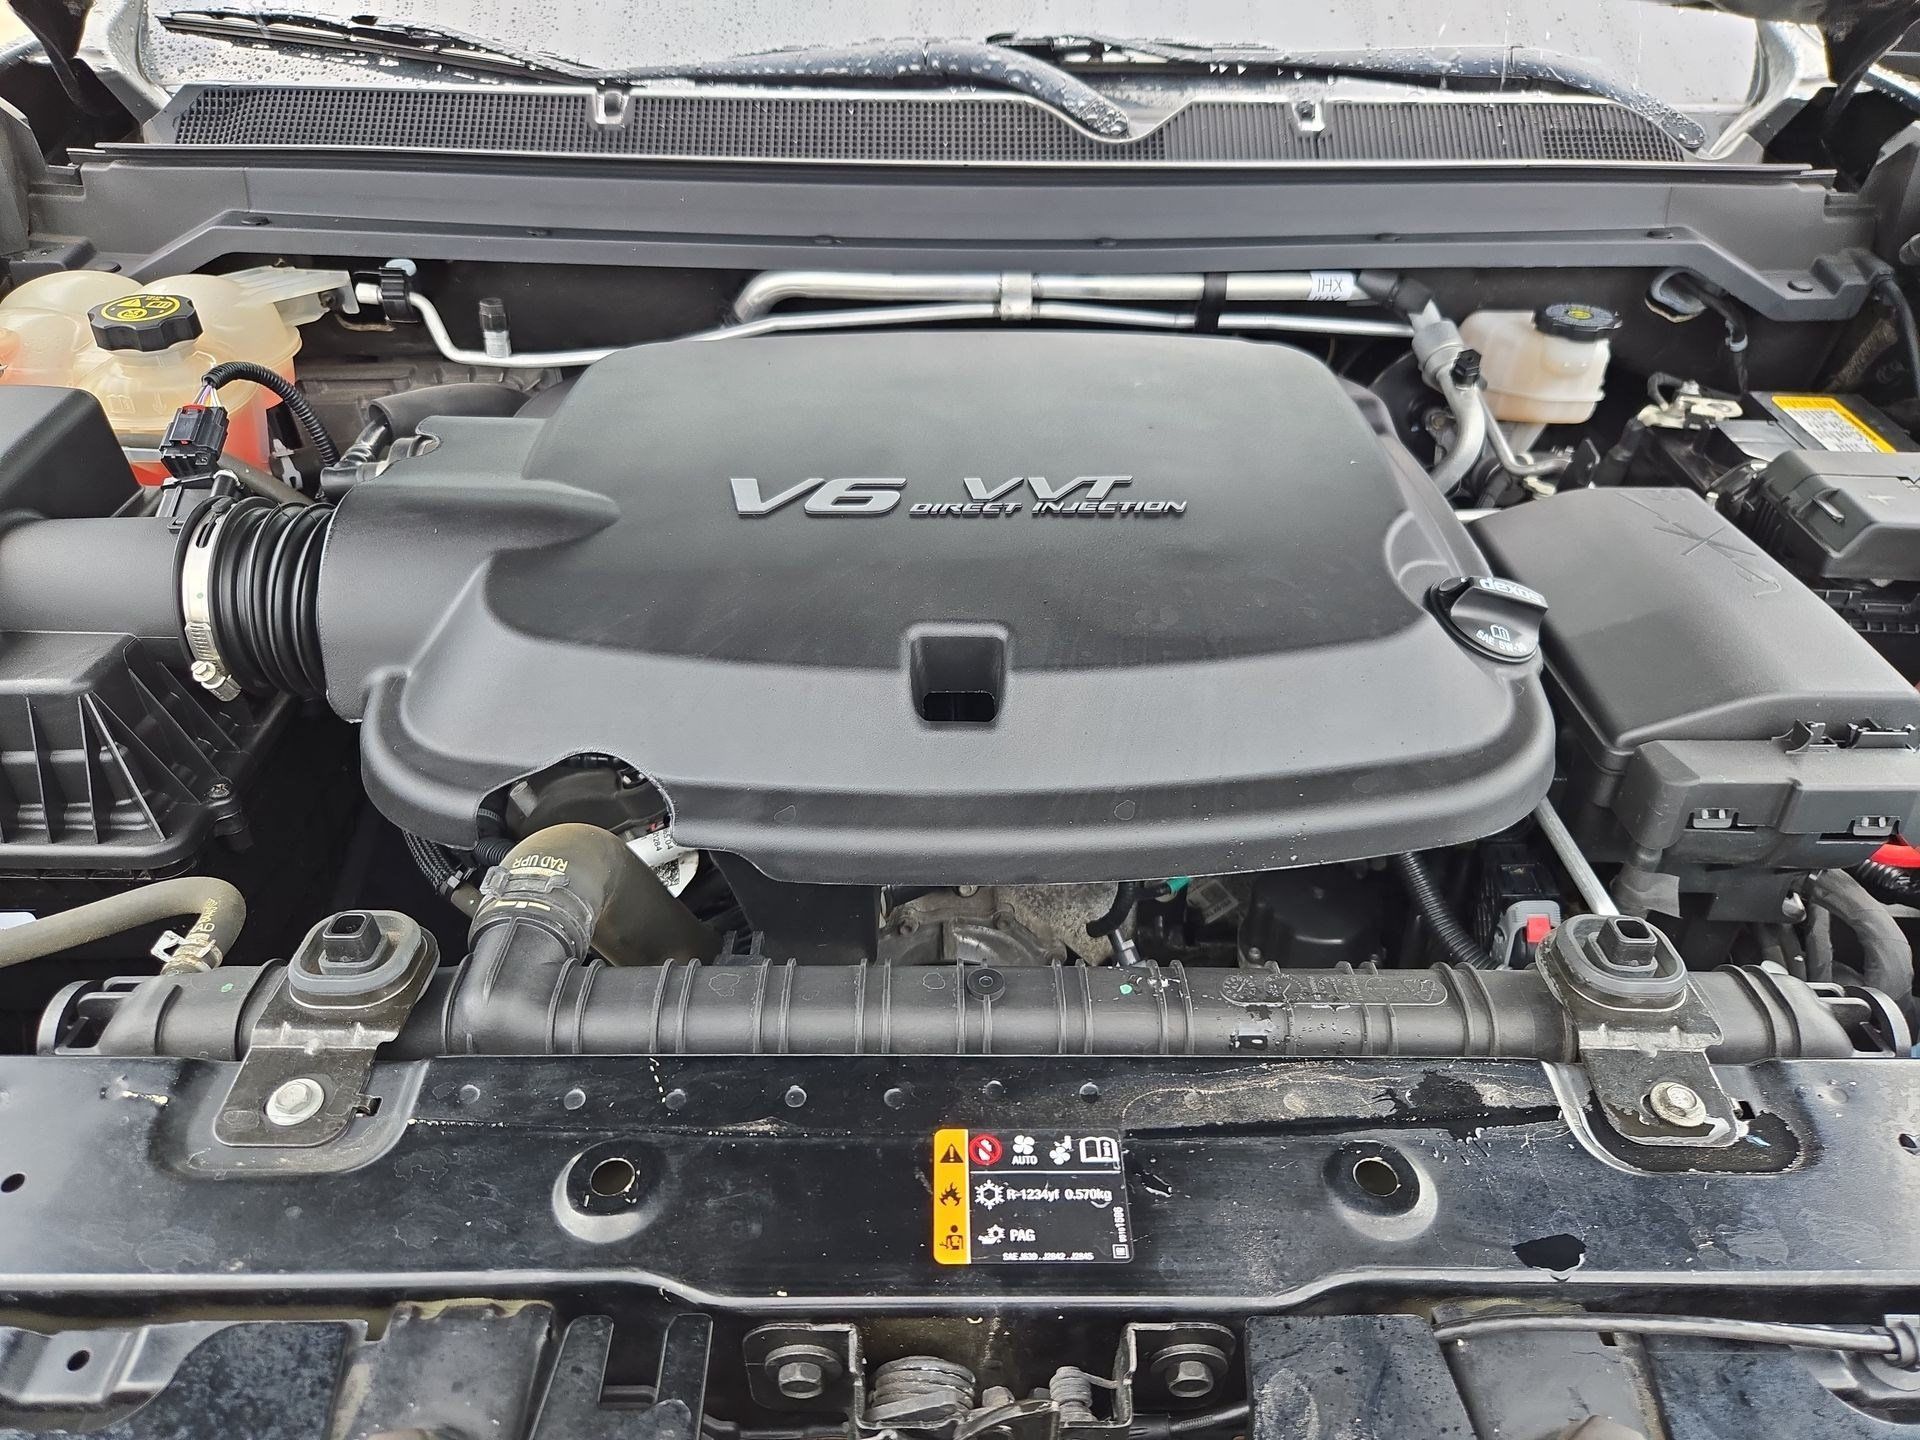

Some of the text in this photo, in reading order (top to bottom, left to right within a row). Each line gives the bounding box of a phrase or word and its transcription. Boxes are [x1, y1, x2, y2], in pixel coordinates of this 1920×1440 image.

[1317, 275, 1343, 293] IHX
[731, 477, 907, 516] V6
[963, 475, 1133, 501] VVT
[909, 500, 1187, 516] DIRECT INJECTION
[1479, 577, 1542, 604] dexos
[1475, 629, 1495, 646] SAE
[512, 854, 568, 872] RAD UPR
[1012, 1155, 1038, 1165] AUTO
[1006, 1188, 1113, 1202] R-1234yf 0.570kg
[1009, 1228, 1036, 1242] PAG
[1002, 1252, 1019, 1261] SAE
